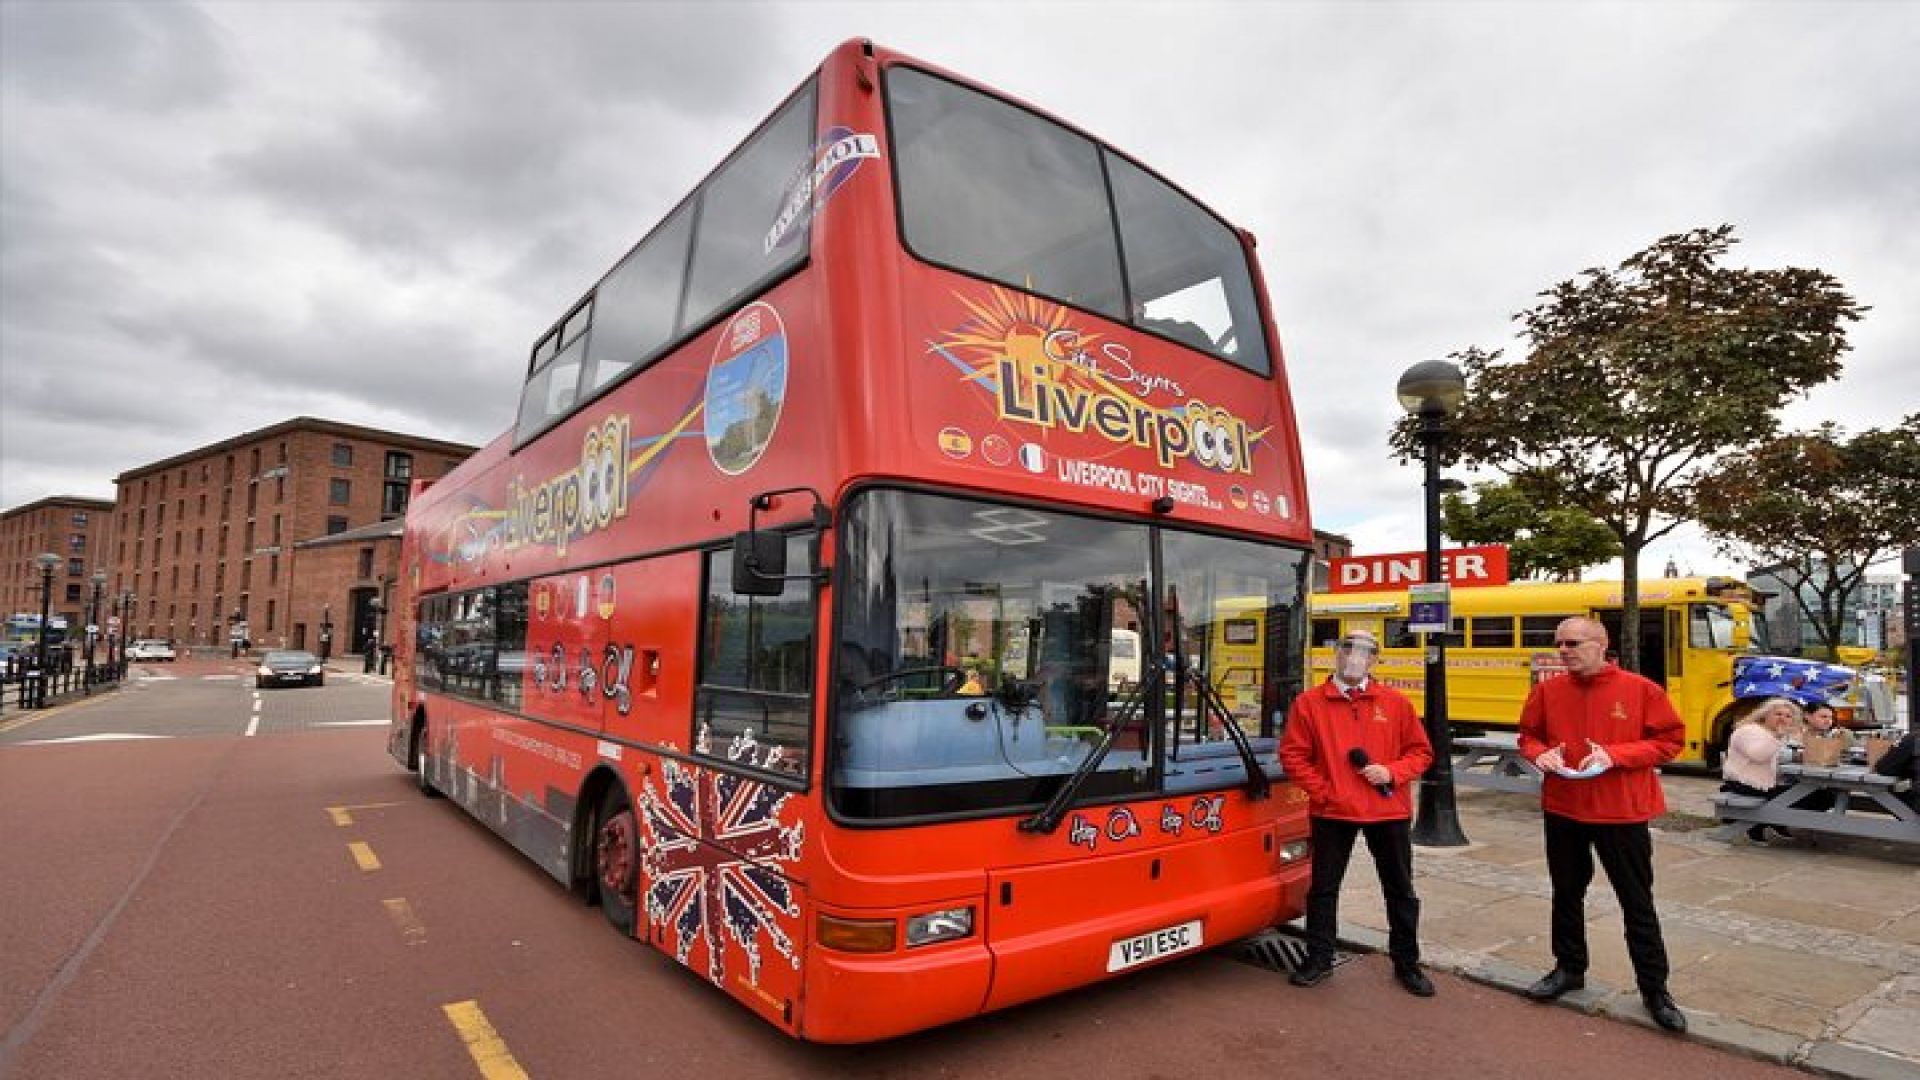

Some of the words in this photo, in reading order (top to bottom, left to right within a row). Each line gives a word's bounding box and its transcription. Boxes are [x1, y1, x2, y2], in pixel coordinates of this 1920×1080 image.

[998, 355, 1254, 474] Liverpool
[1058, 457, 1136, 493] LIVERPOOL
[1137, 472, 1165, 497] CITY
[1070, 814, 1099, 851] Hop
[1105, 807, 1141, 842] On
[1191, 795, 1225, 832] Off
[1157, 926, 1189, 953] ESC
